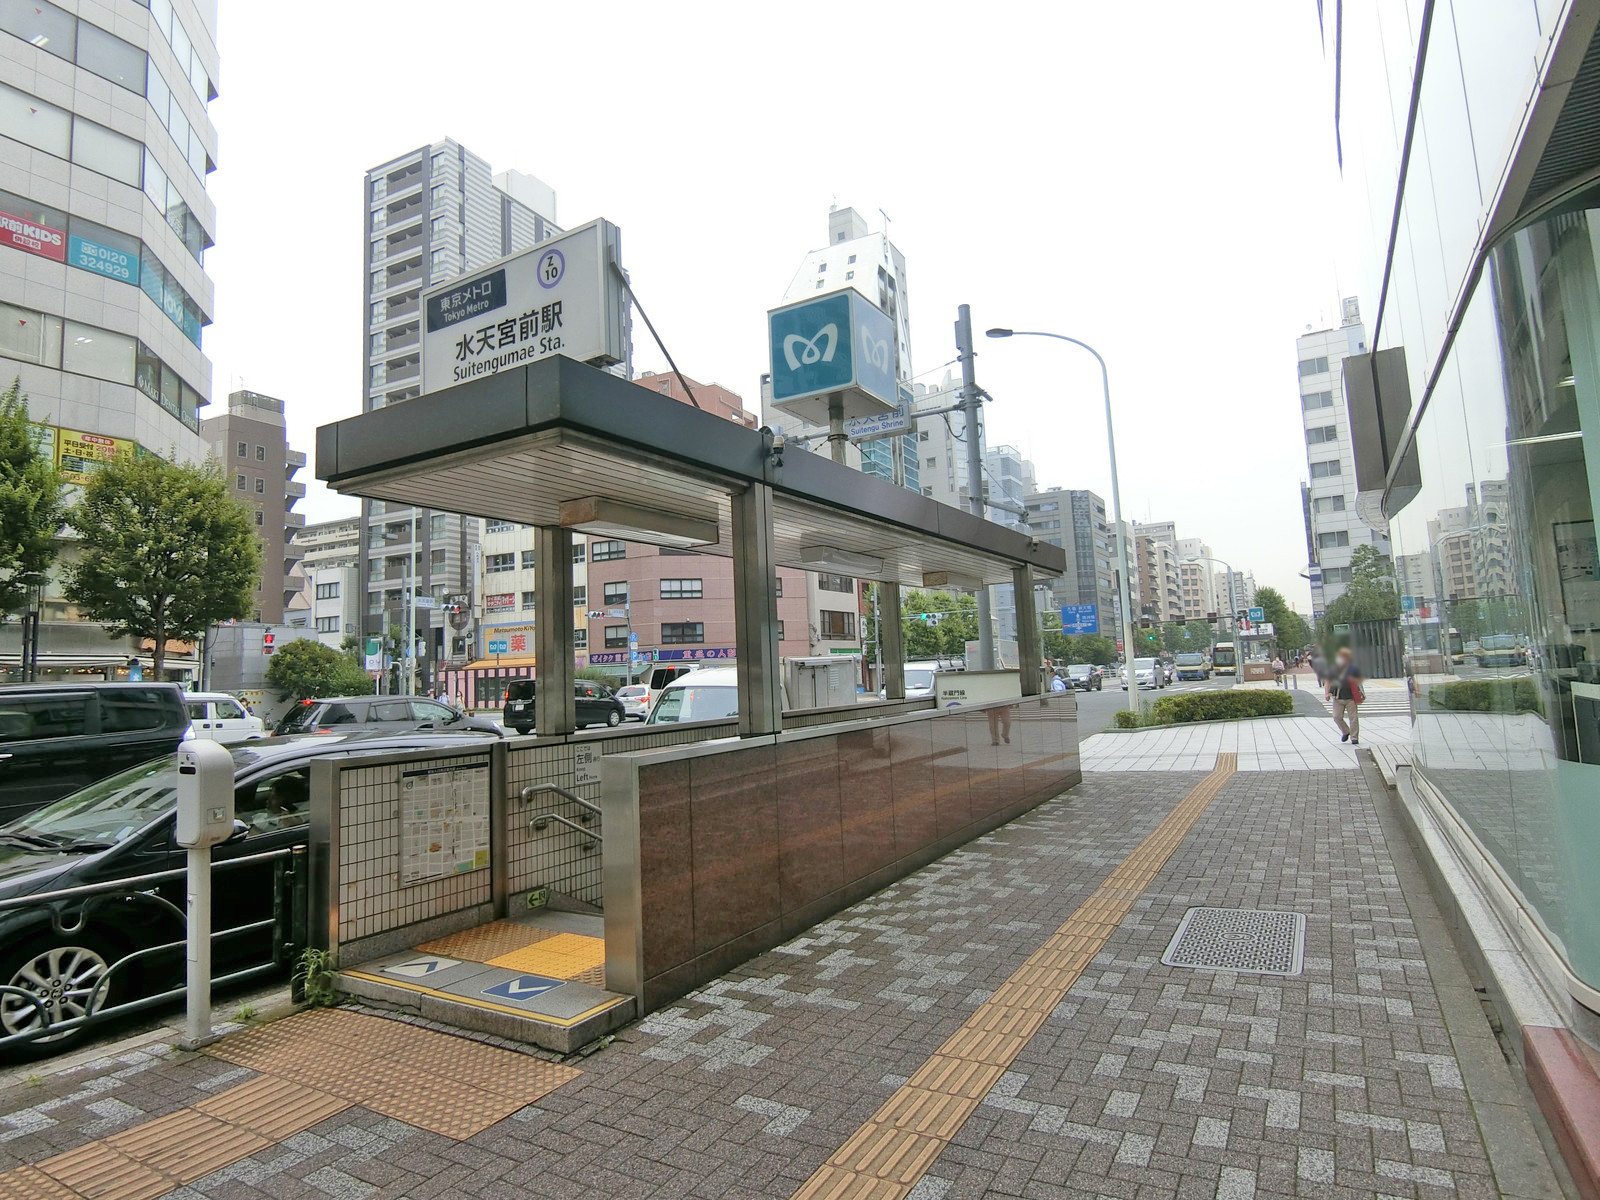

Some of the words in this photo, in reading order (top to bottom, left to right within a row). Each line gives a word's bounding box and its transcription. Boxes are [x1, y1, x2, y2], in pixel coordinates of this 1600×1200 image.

[99, 248, 128, 266] 0120
[547, 256, 554, 266] Z
[79, 254, 130, 279] 324929
[545, 266, 558, 281] 10
[440, 280, 492, 312] 東京メトロ
[444, 308, 465, 323] Tokyo
[466, 299, 489, 315] Metro
[455, 300, 563, 362] 水天宮前駅
[453, 344, 535, 382] Suitengumae
[540, 336, 566, 354] Sta.
[850, 424, 880, 436] Suitengu
[881, 419, 904, 430] Shrine
[510, 634, 527, 652] 薬
[576, 773, 589, 782] Left
